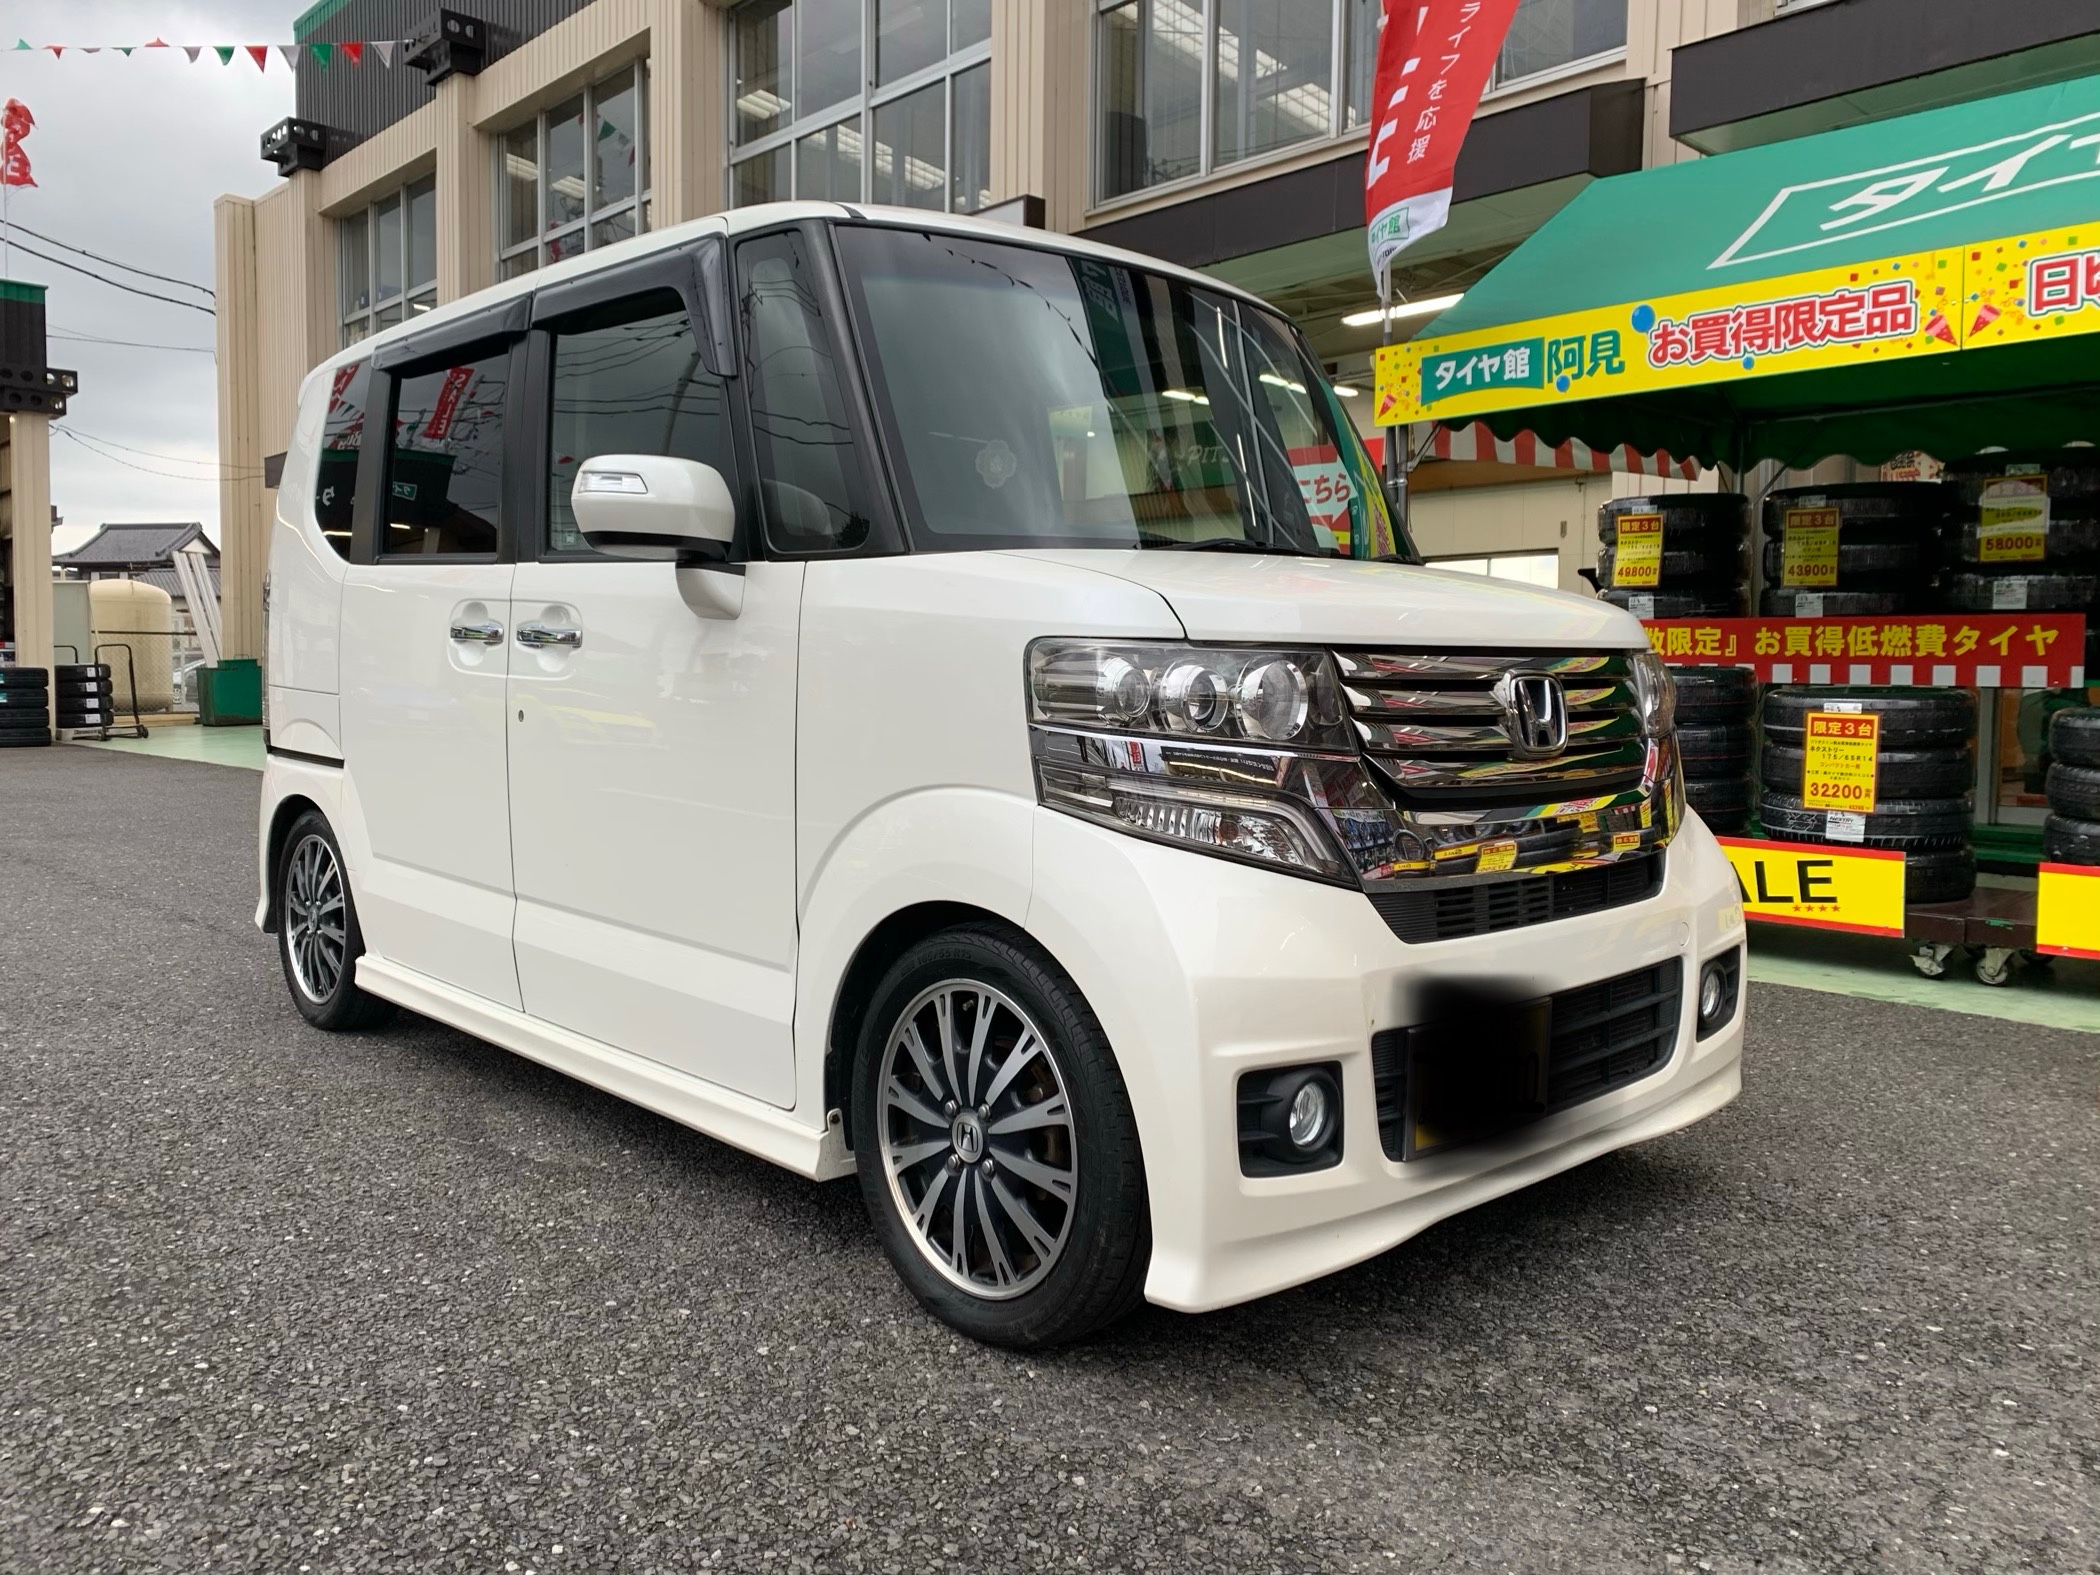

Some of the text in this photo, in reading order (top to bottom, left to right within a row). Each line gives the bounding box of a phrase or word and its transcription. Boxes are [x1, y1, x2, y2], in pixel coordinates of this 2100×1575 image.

[1649, 283, 1915, 366] お買得限定品
[1434, 329, 1626, 391] タイヤ館 阿見
[1813, 721, 1873, 737] 限定3台
